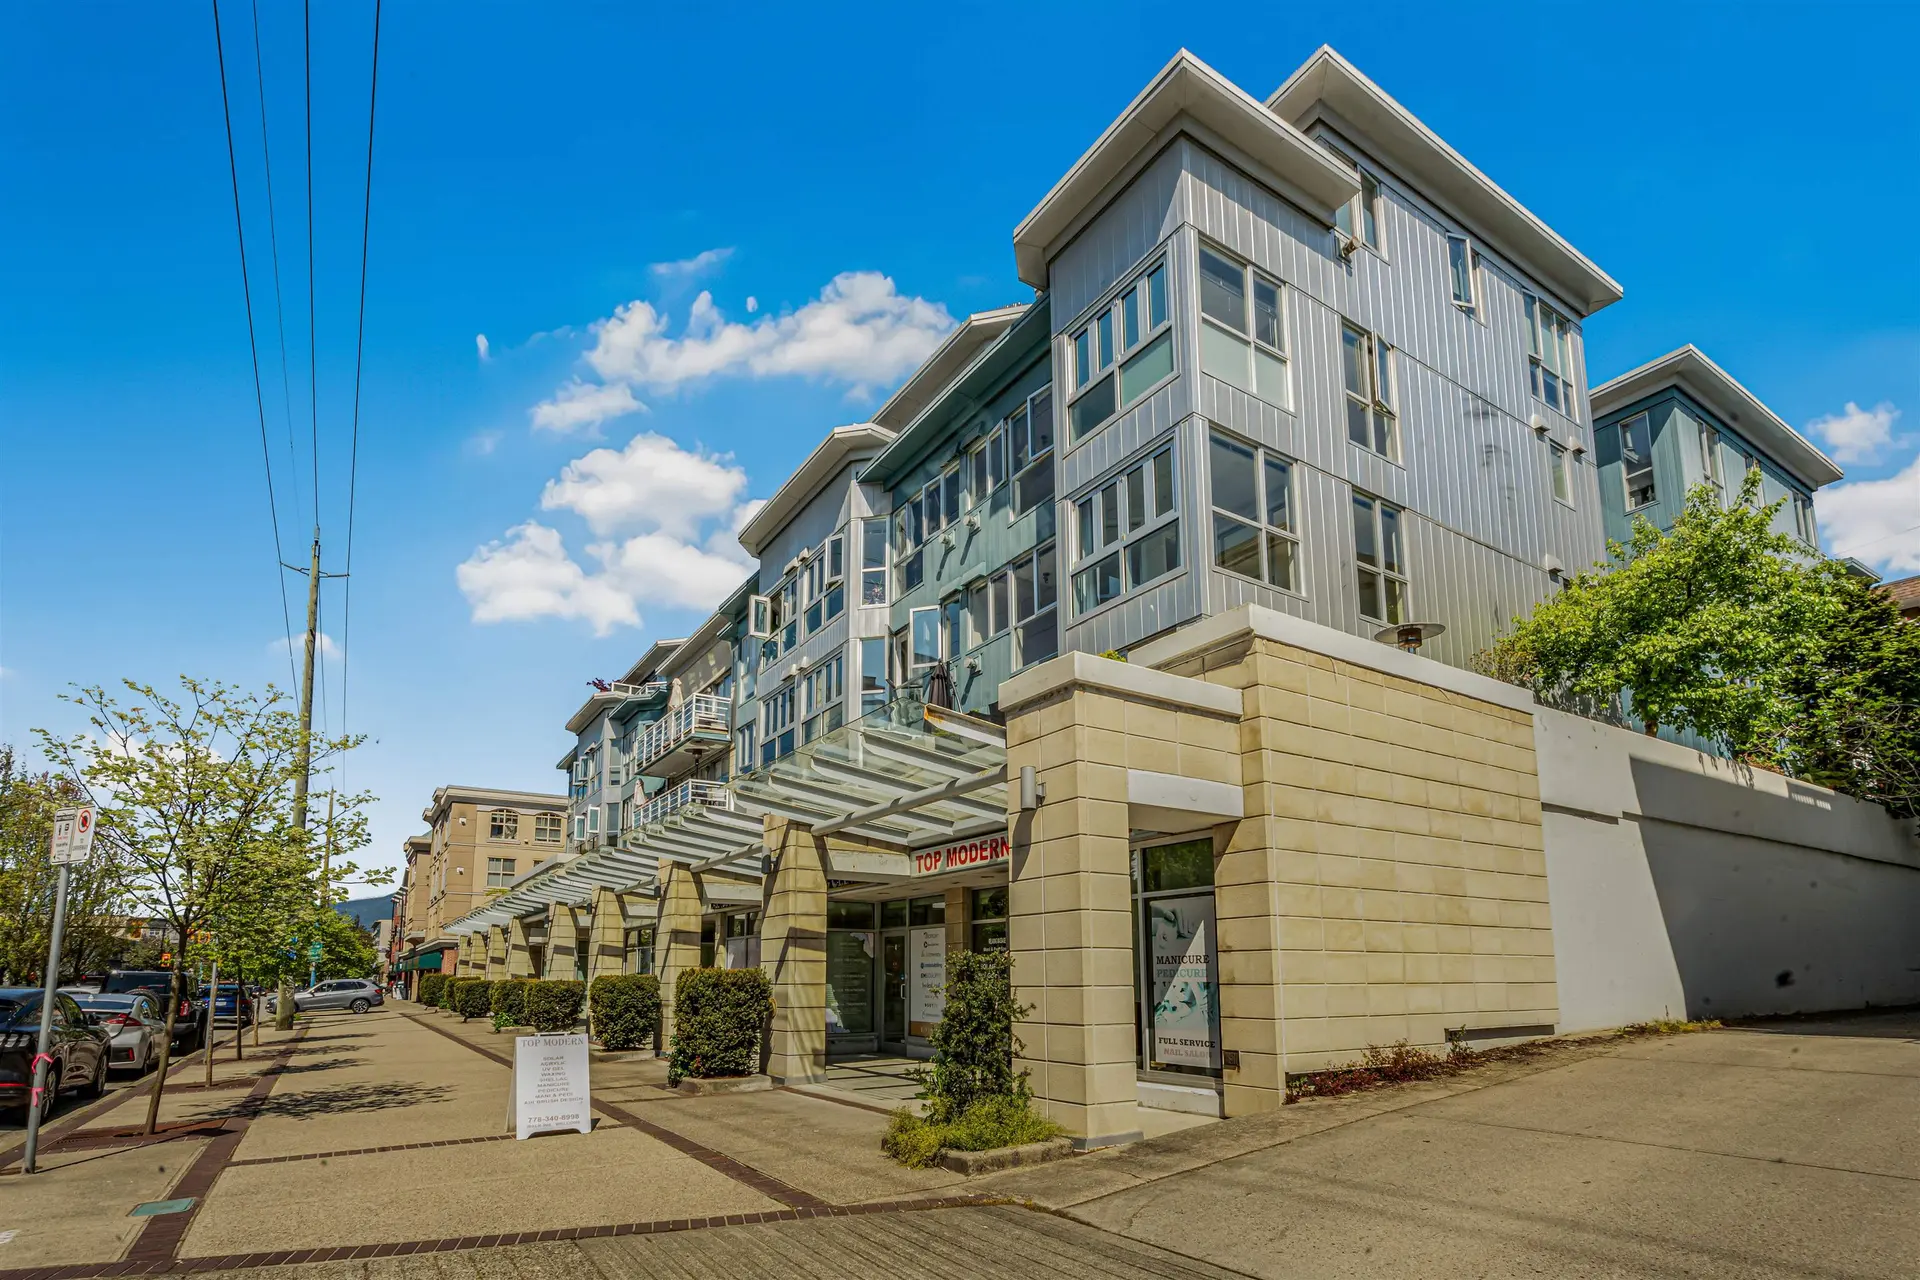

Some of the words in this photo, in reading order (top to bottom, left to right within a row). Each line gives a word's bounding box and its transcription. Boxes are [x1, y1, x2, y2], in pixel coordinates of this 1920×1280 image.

[916, 850, 942, 873] TOP
[946, 836, 1010, 867] MODERN
[1156, 954, 1210, 965] MANICURE
[1156, 968, 1208, 978] PEDICURE
[521, 1039, 540, 1048] TOP
[543, 1037, 584, 1047] MODERN
[1158, 1037, 1178, 1045] FULL
[1180, 1038, 1216, 1048] SERVICE
[1164, 1048, 1183, 1057] NAIL
[1184, 1050, 1213, 1059] SALON
[527, 1113, 580, 1123] 778-340-8998
